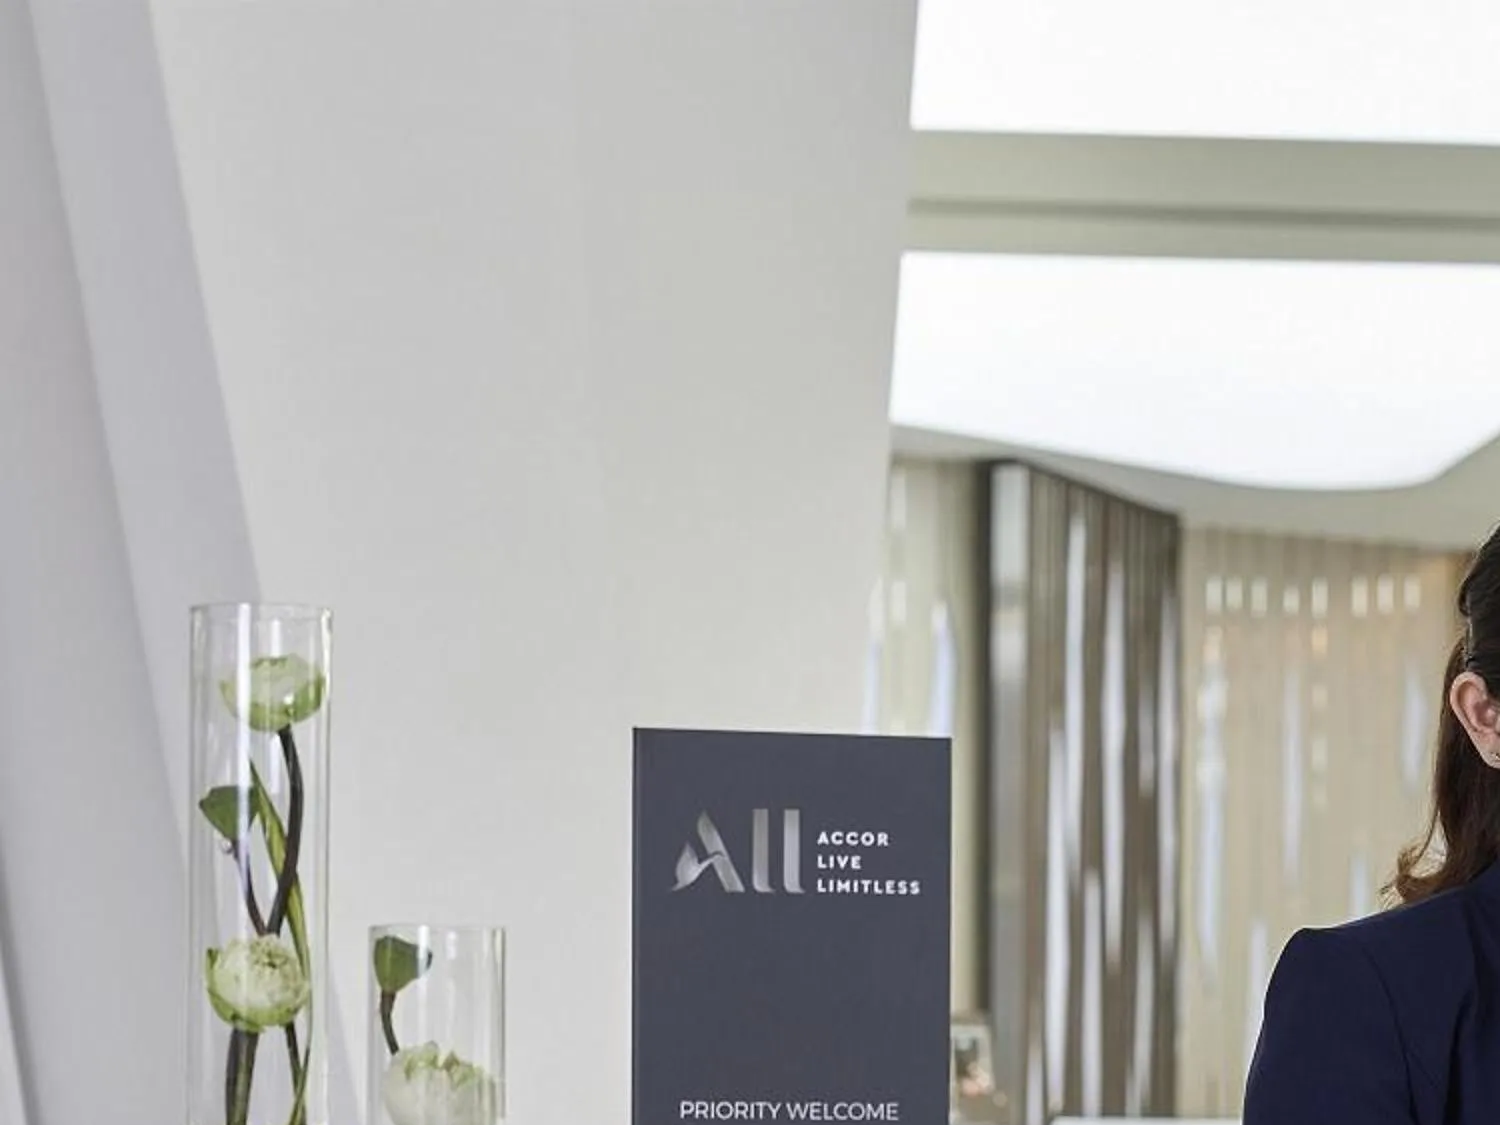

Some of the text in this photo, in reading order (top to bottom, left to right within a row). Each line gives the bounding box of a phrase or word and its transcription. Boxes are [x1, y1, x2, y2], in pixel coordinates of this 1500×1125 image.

[816, 831, 890, 847] ACCOR
[816, 855, 862, 870] LIVE
[816, 878, 921, 895] LIMITLESS
[679, 1100, 900, 1121] PRIORITY WELCOME
